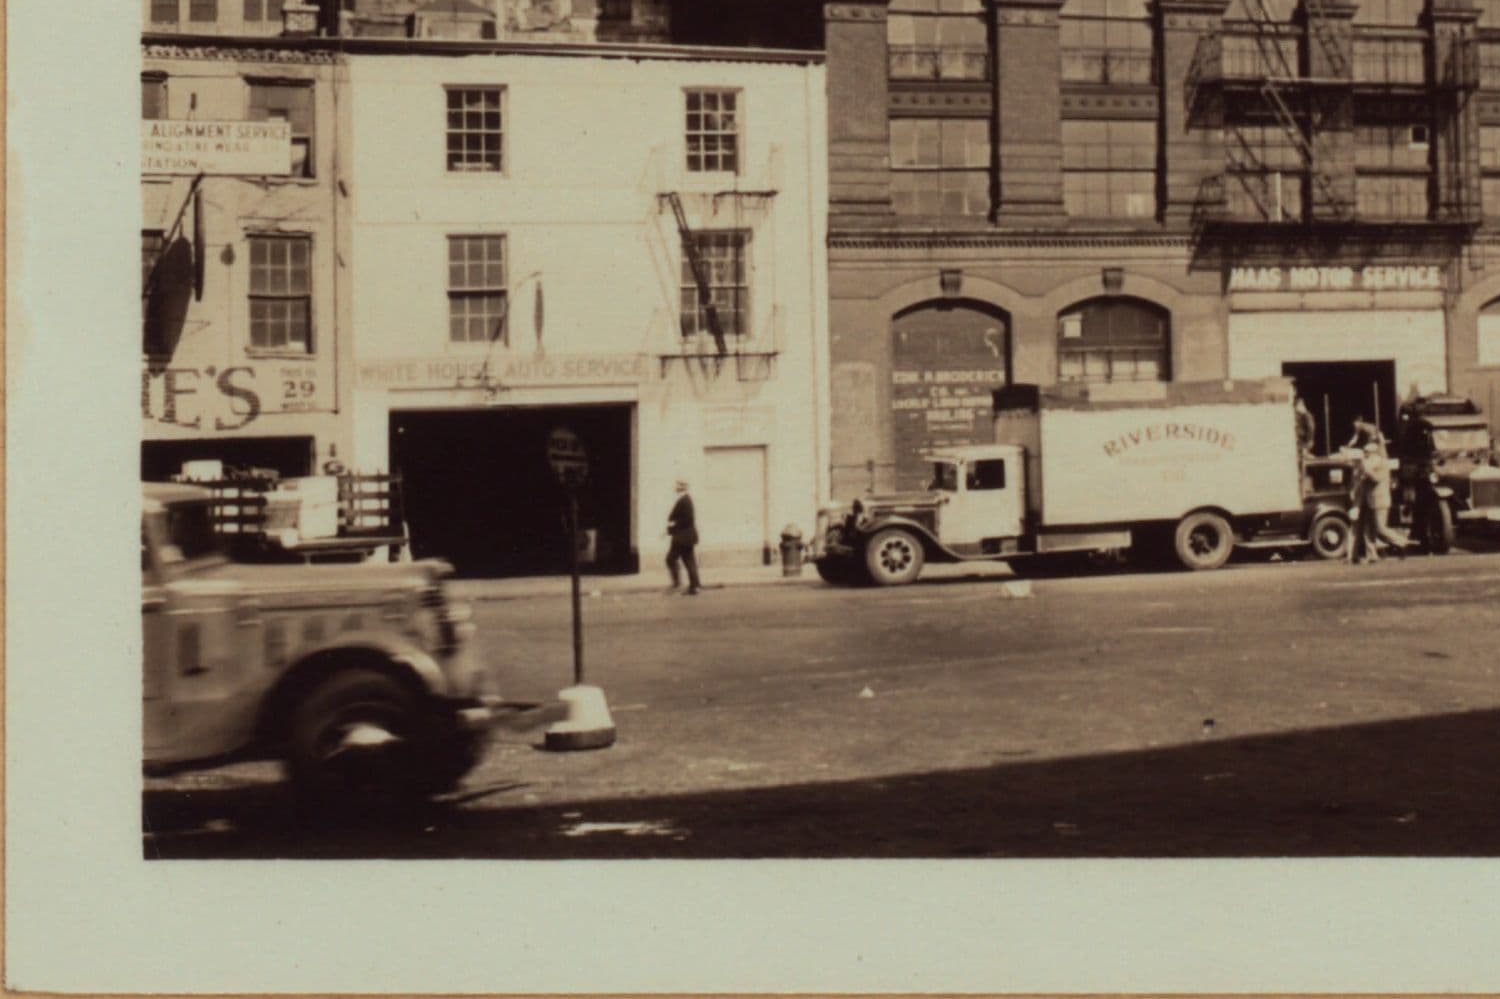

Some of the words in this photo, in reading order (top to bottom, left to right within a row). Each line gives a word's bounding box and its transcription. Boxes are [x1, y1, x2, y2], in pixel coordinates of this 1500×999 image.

[152, 123, 232, 138] ALIGNMENT
[238, 124, 290, 139] SERVICE
[1229, 266, 1282, 290] HAAS
[1290, 265, 1354, 290] MOTOR
[1361, 265, 1441, 290] SERVICE
[359, 362, 418, 382] WHITE
[427, 360, 496, 380] HOUSE
[504, 359, 558, 379] AUTO
[563, 357, 643, 378] SERVICE
[283, 380, 316, 399] 29
[1103, 423, 1236, 457] RIVERSIDE
